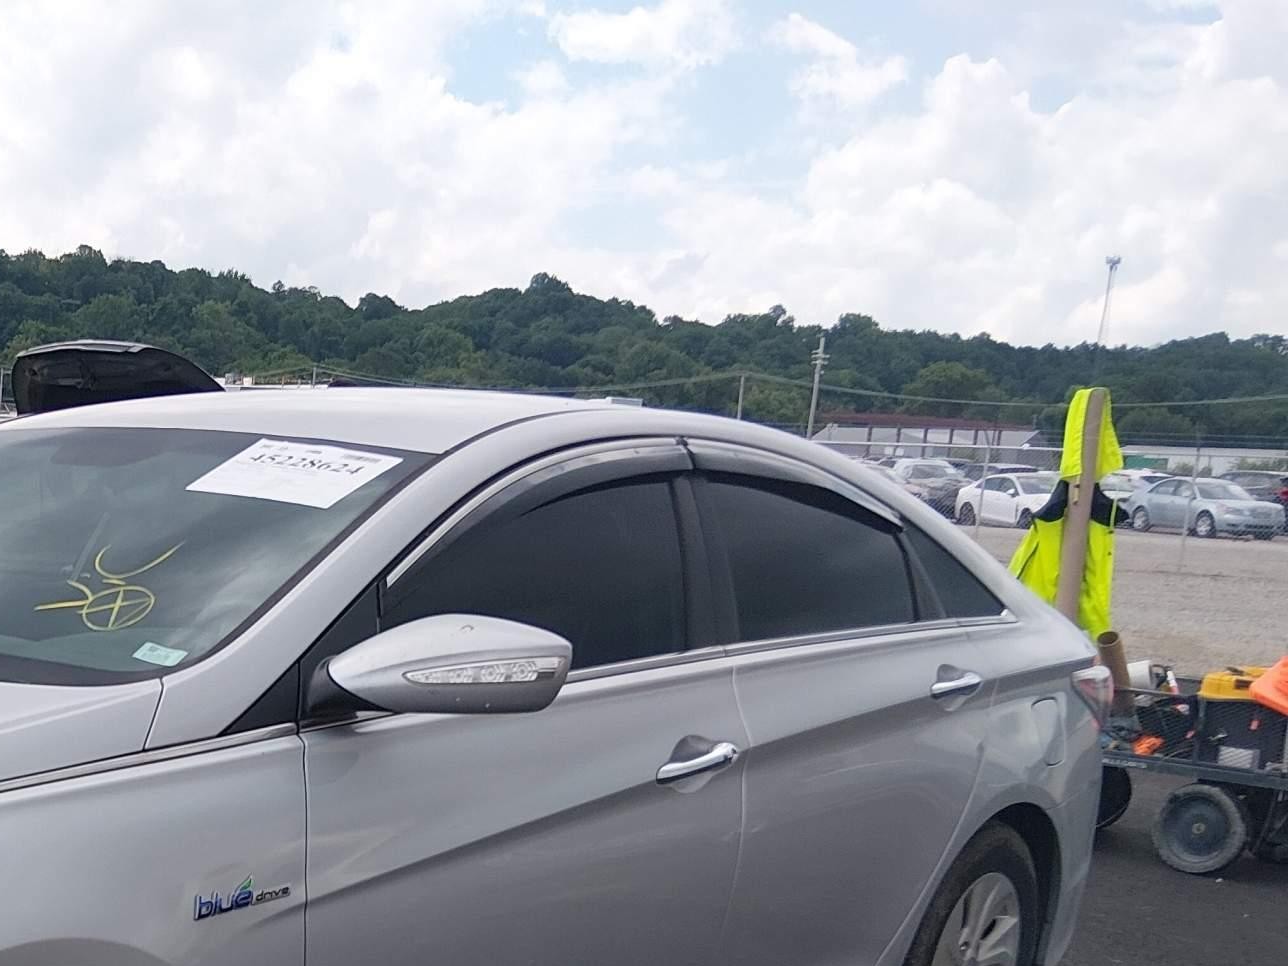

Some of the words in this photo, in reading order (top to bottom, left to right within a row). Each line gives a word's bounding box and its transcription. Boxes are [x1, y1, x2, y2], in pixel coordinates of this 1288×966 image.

[250, 453, 365, 475] 45228624
[194, 889, 253, 921] blue
[255, 886, 290, 902] drive
